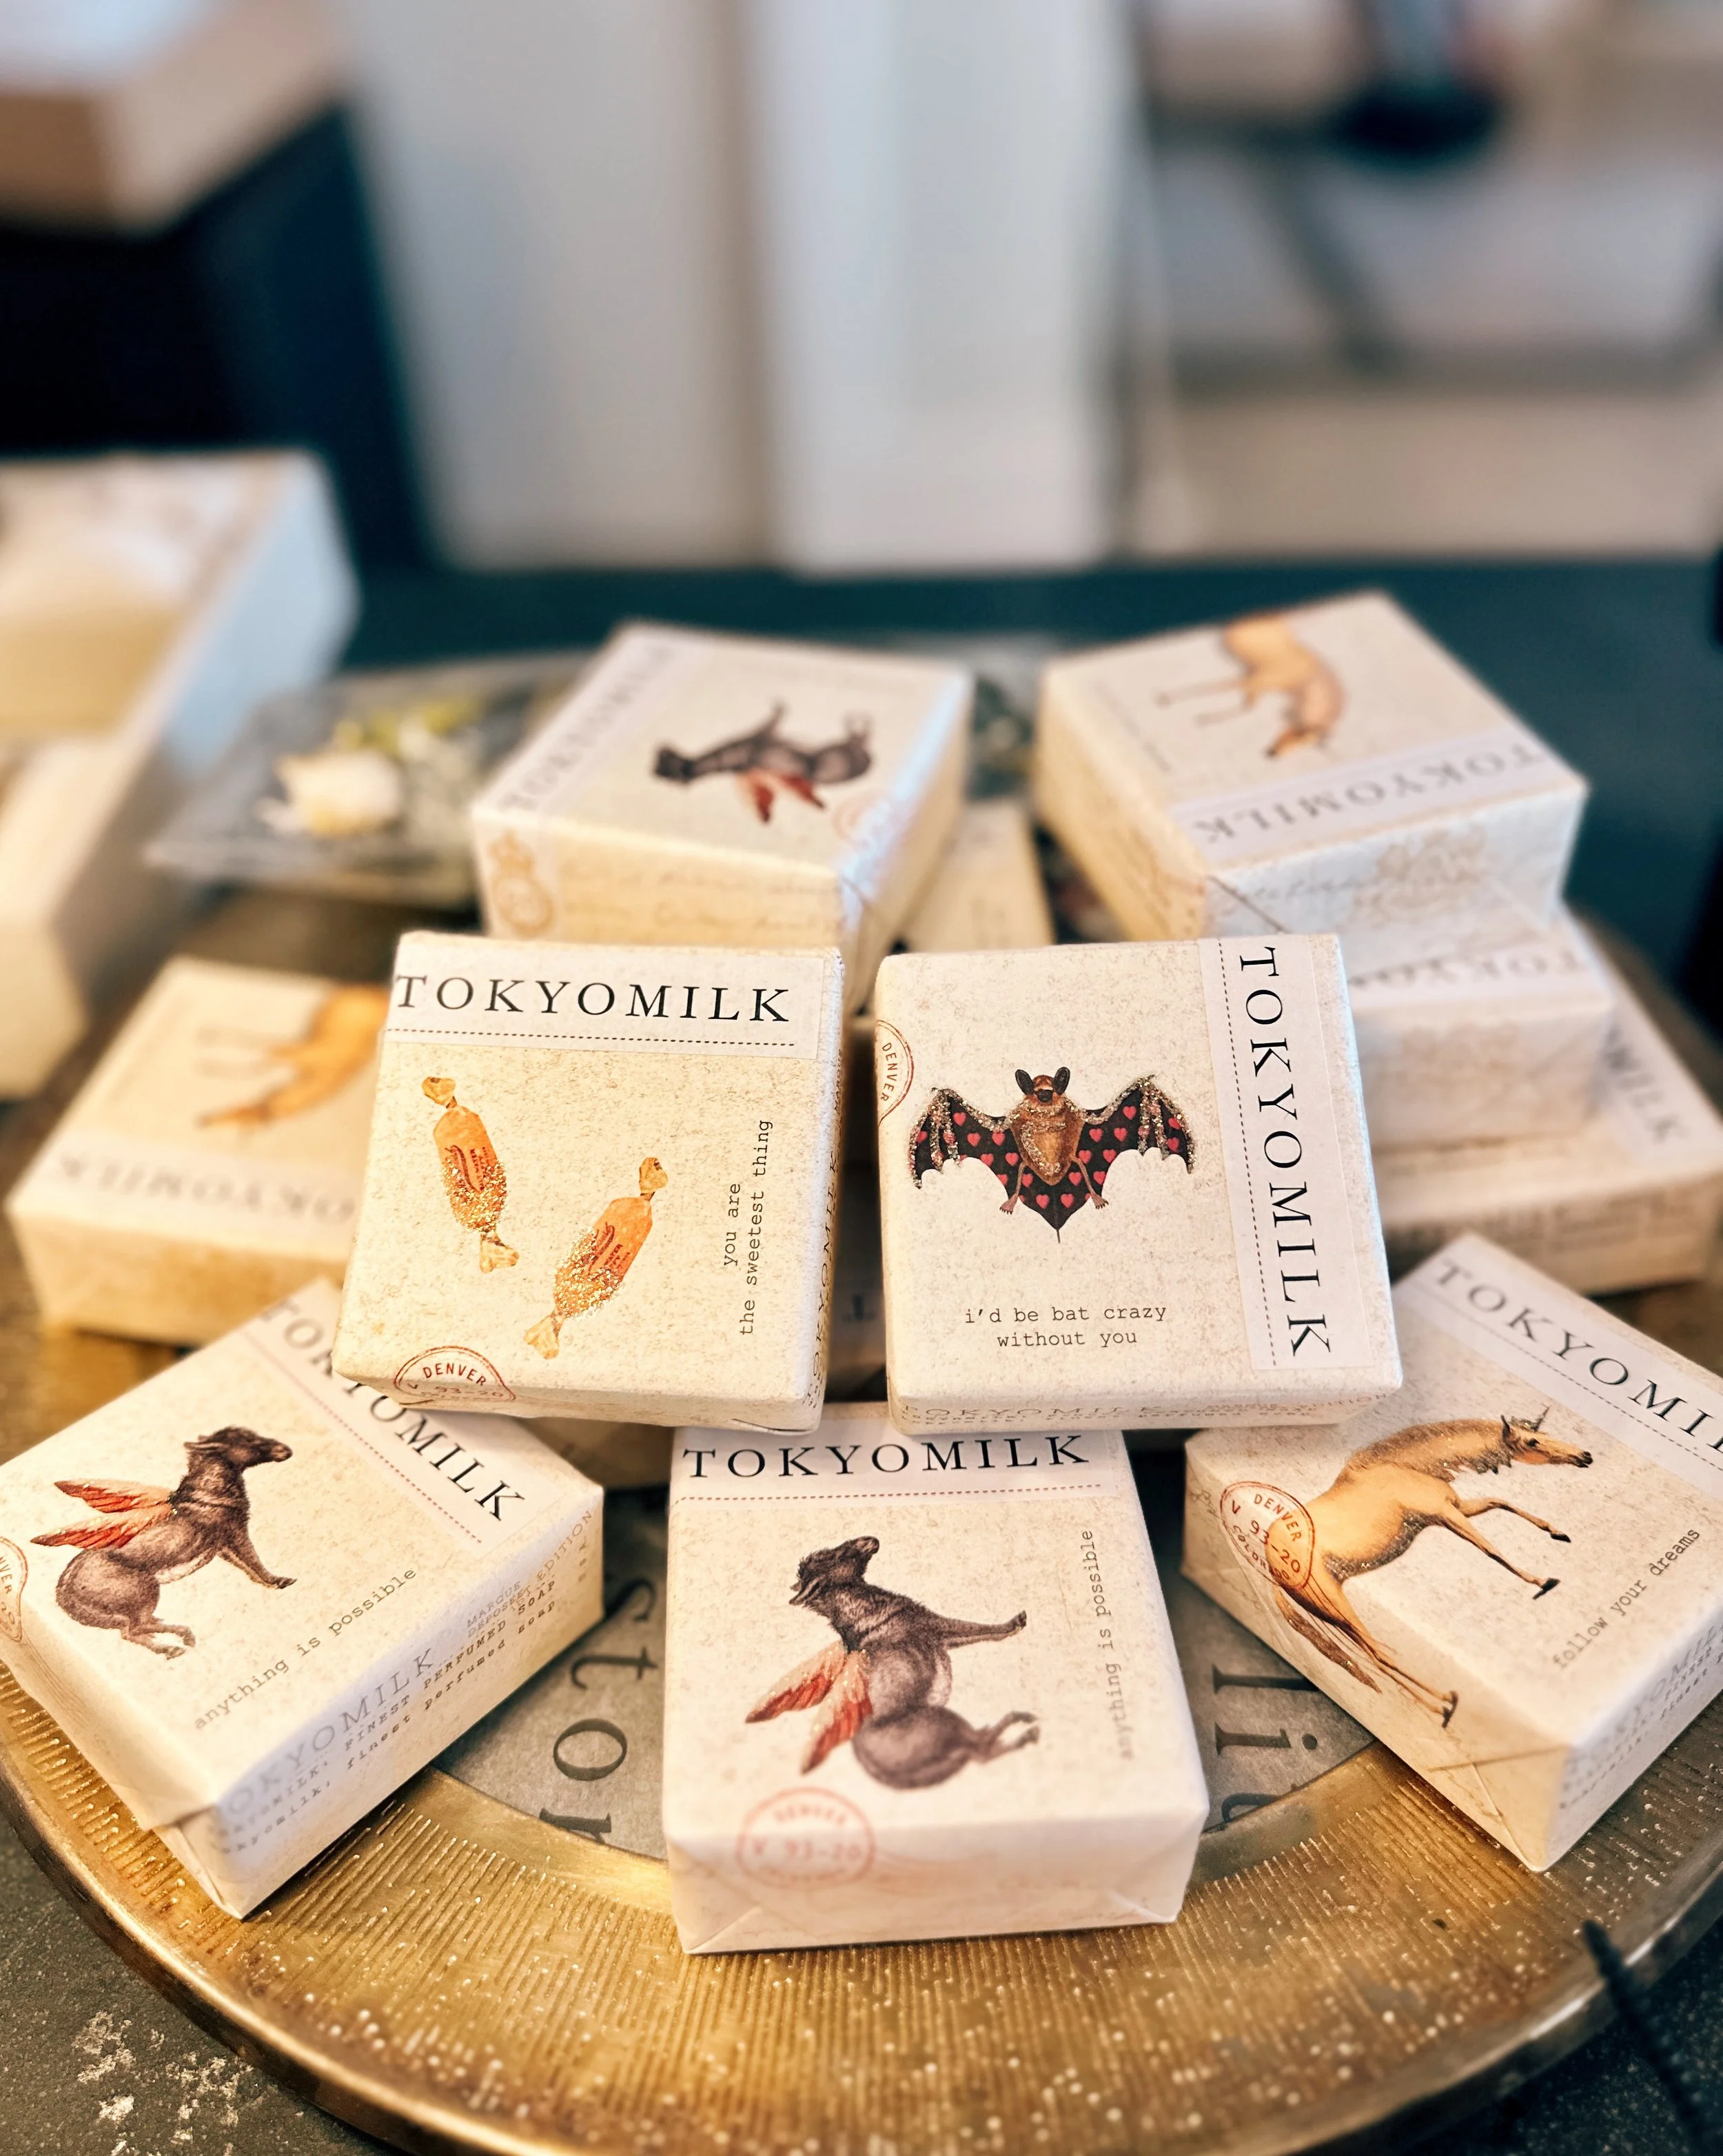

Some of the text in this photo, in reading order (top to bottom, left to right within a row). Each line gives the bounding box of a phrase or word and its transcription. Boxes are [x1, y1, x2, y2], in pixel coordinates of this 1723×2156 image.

[396, 974, 791, 1023] TOKYOMILK
[880, 1042, 898, 1102] DENVER
[1240, 945, 1332, 1357] TOKYOMILK
[723, 1182, 741, 1267] you are
[739, 1120, 773, 1335] the sweetest thing
[965, 1306, 1167, 1324] i'd be bat crazy
[997, 1331, 1138, 1348] without you
[422, 1362, 487, 1386] DENVER
[682, 1434, 1090, 1479] TOKYOMILK
[1231, 1499, 1301, 1574] V 93-20
[1254, 1493, 1302, 1543] DENVER
[1552, 1528, 1700, 1670] follow your dreams
[194, 1568, 417, 1729] anything is possible
[345, 1694, 410, 1751] FINEST
[424, 1619, 507, 1690] PERFUMED
[518, 1580, 555, 1616] SOAP
[1080, 1530, 1135, 1760] anything is possible
[347, 1713, 411, 1770] finest
[425, 1639, 507, 1711] perfumed
[518, 1601, 555, 1634] soap
